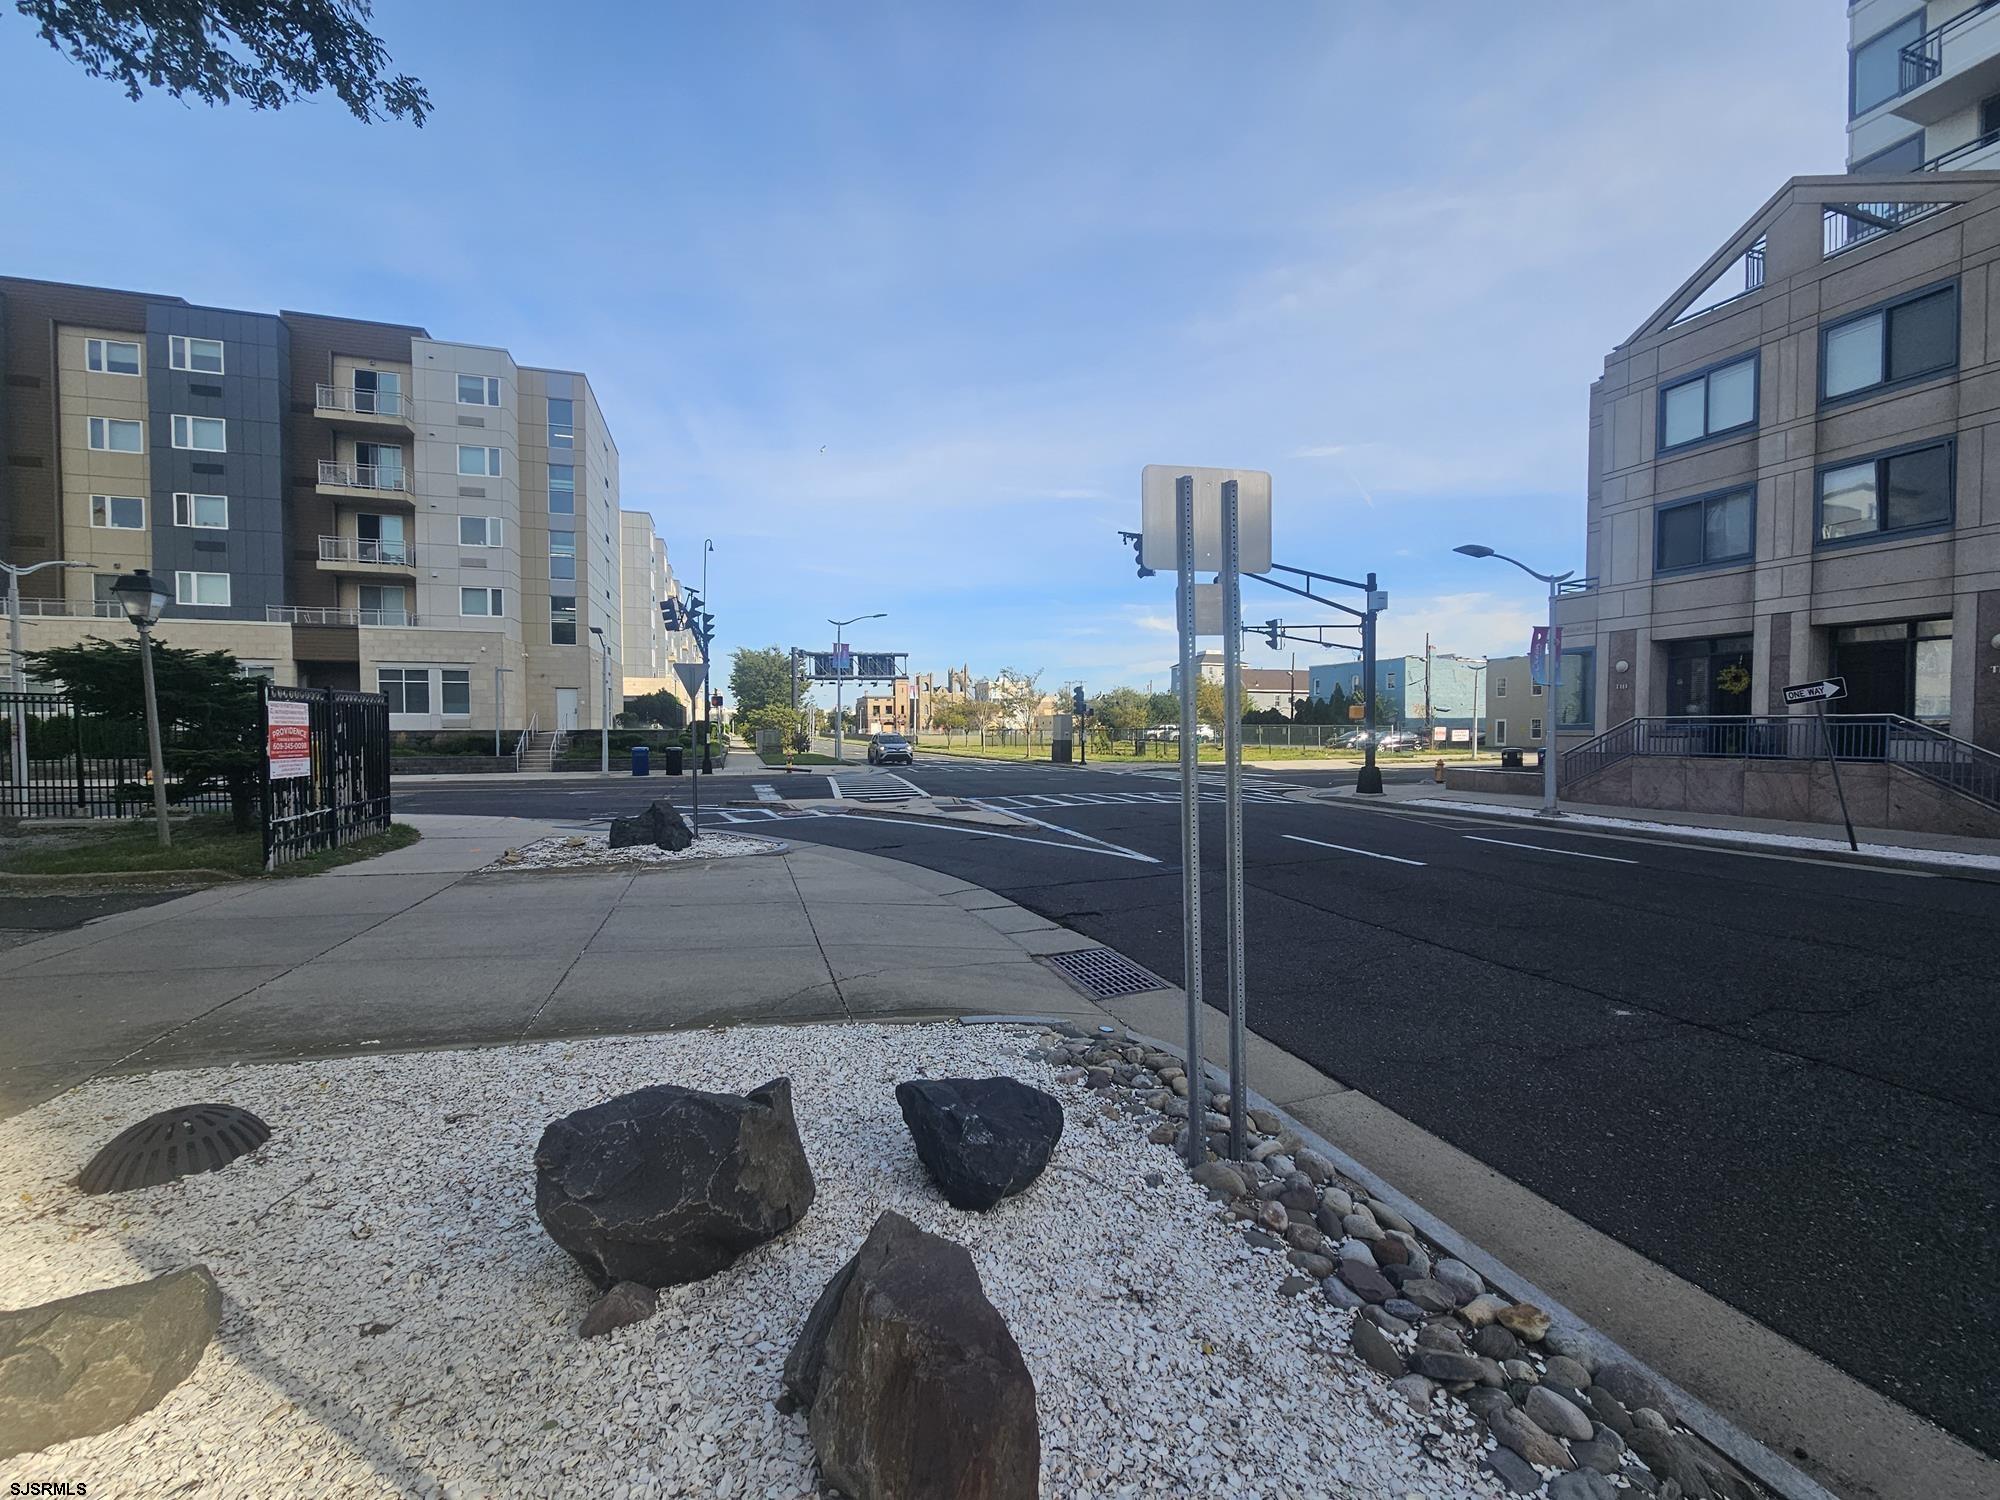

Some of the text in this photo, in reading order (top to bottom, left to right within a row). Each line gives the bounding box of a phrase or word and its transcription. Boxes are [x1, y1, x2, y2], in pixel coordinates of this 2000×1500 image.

[1788, 686, 1824, 699] ONE WAY
[272, 727, 307, 738] PROVIDENCE
